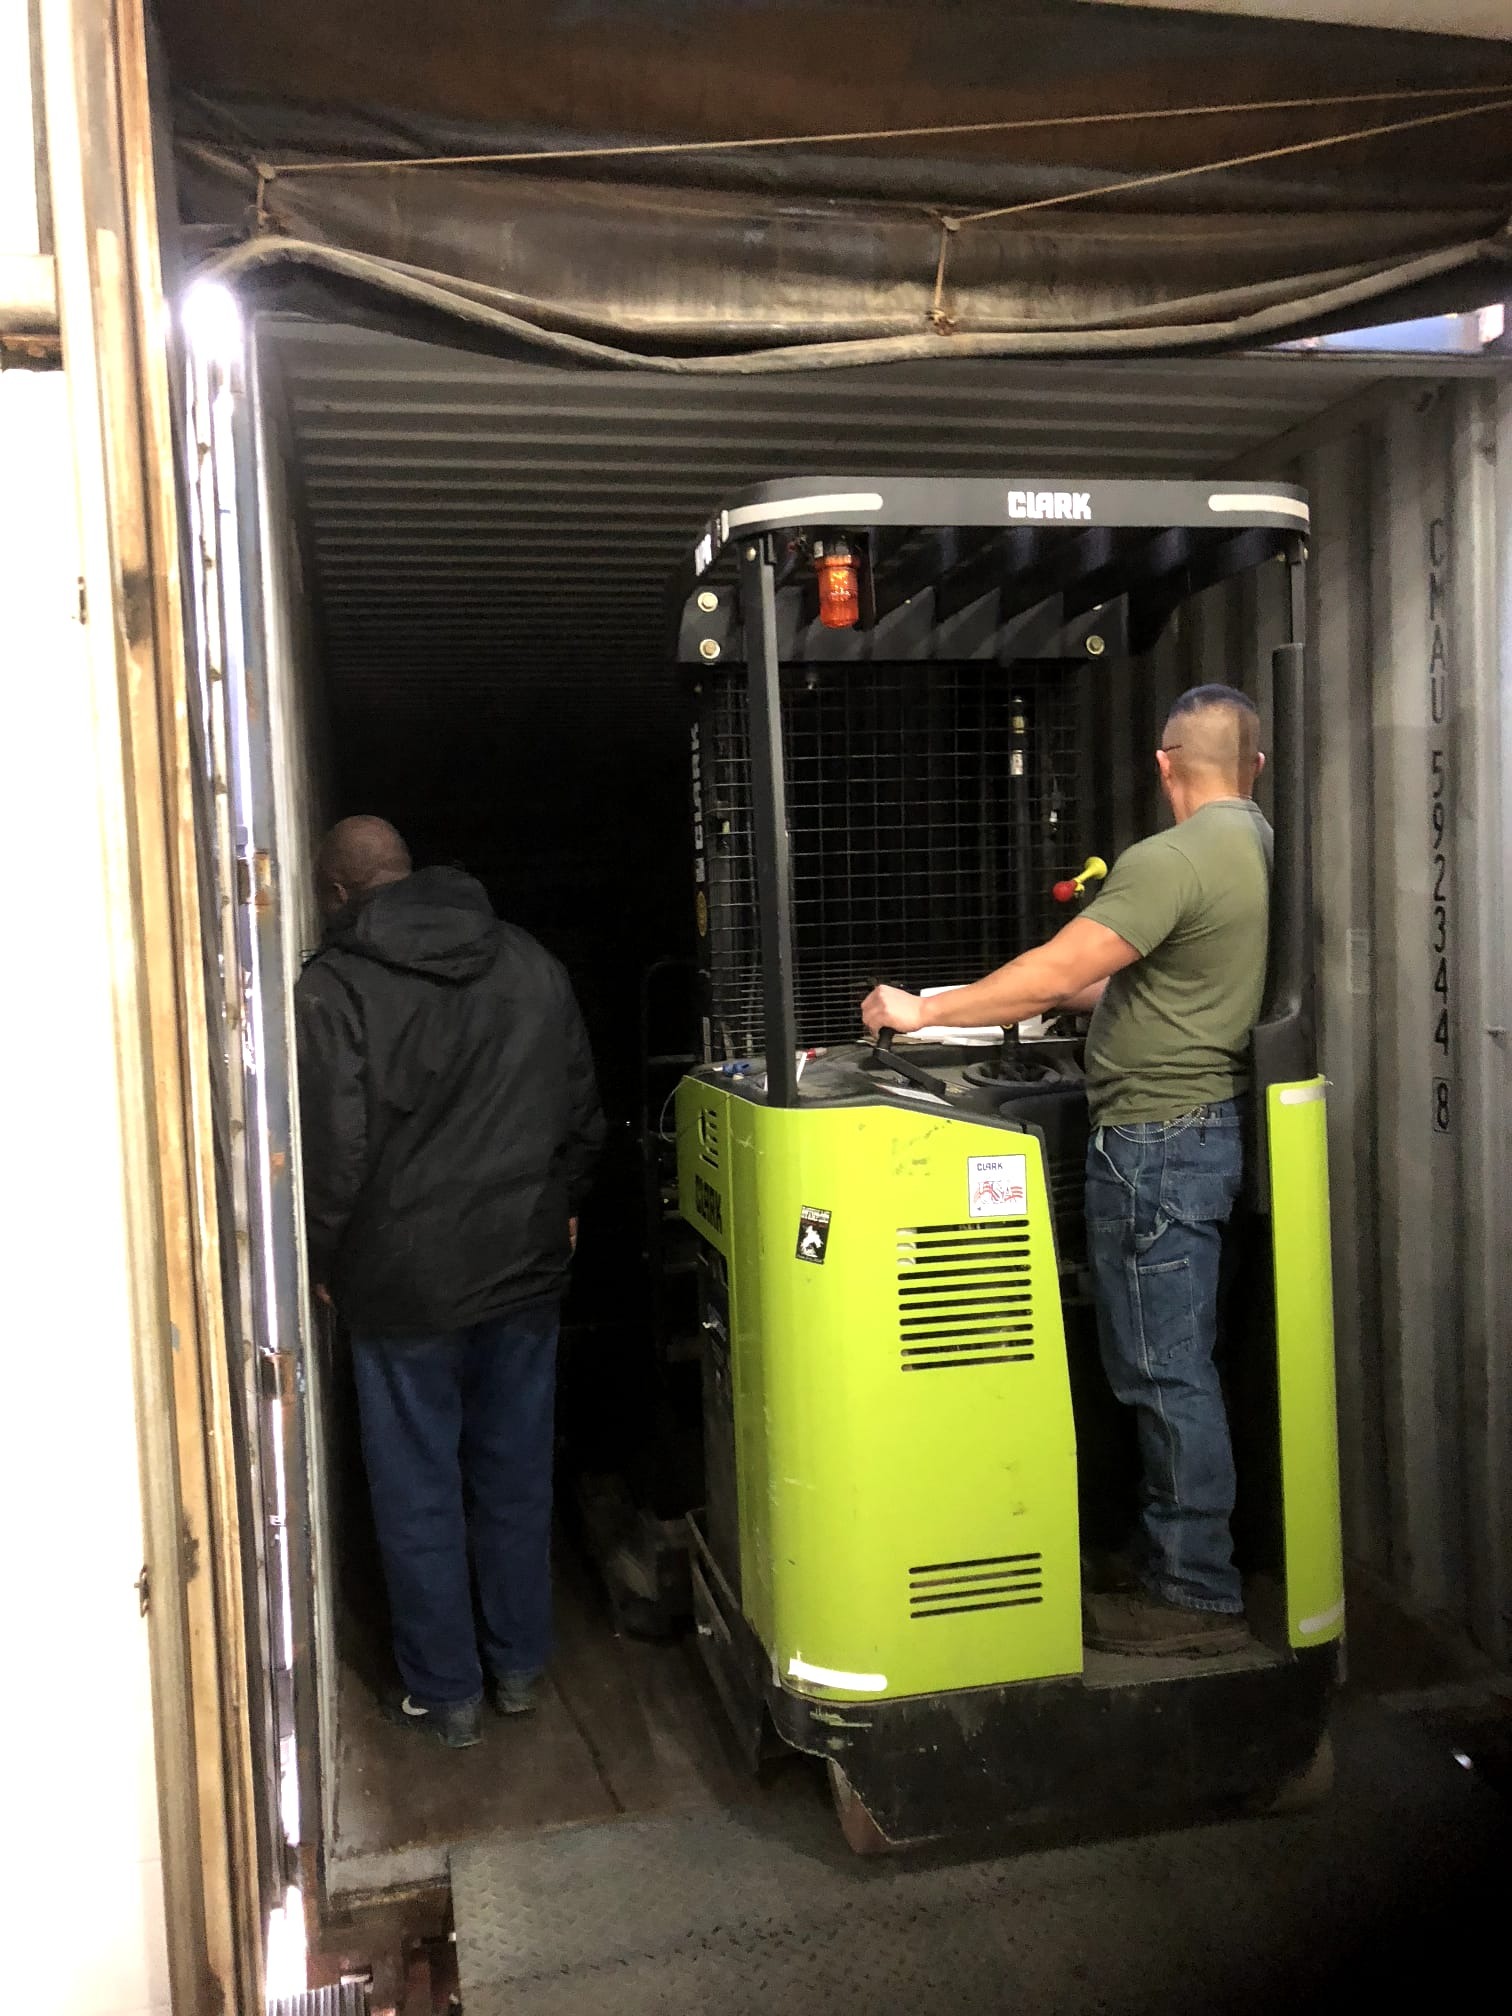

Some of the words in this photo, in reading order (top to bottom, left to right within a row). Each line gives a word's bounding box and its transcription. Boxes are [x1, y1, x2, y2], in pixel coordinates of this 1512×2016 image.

[1007, 491, 1092, 520] CLARK
[1431, 750, 1449, 1056] 592344
[1436, 1082, 1450, 1130] 8
[977, 1163, 1003, 1171] CLARK
